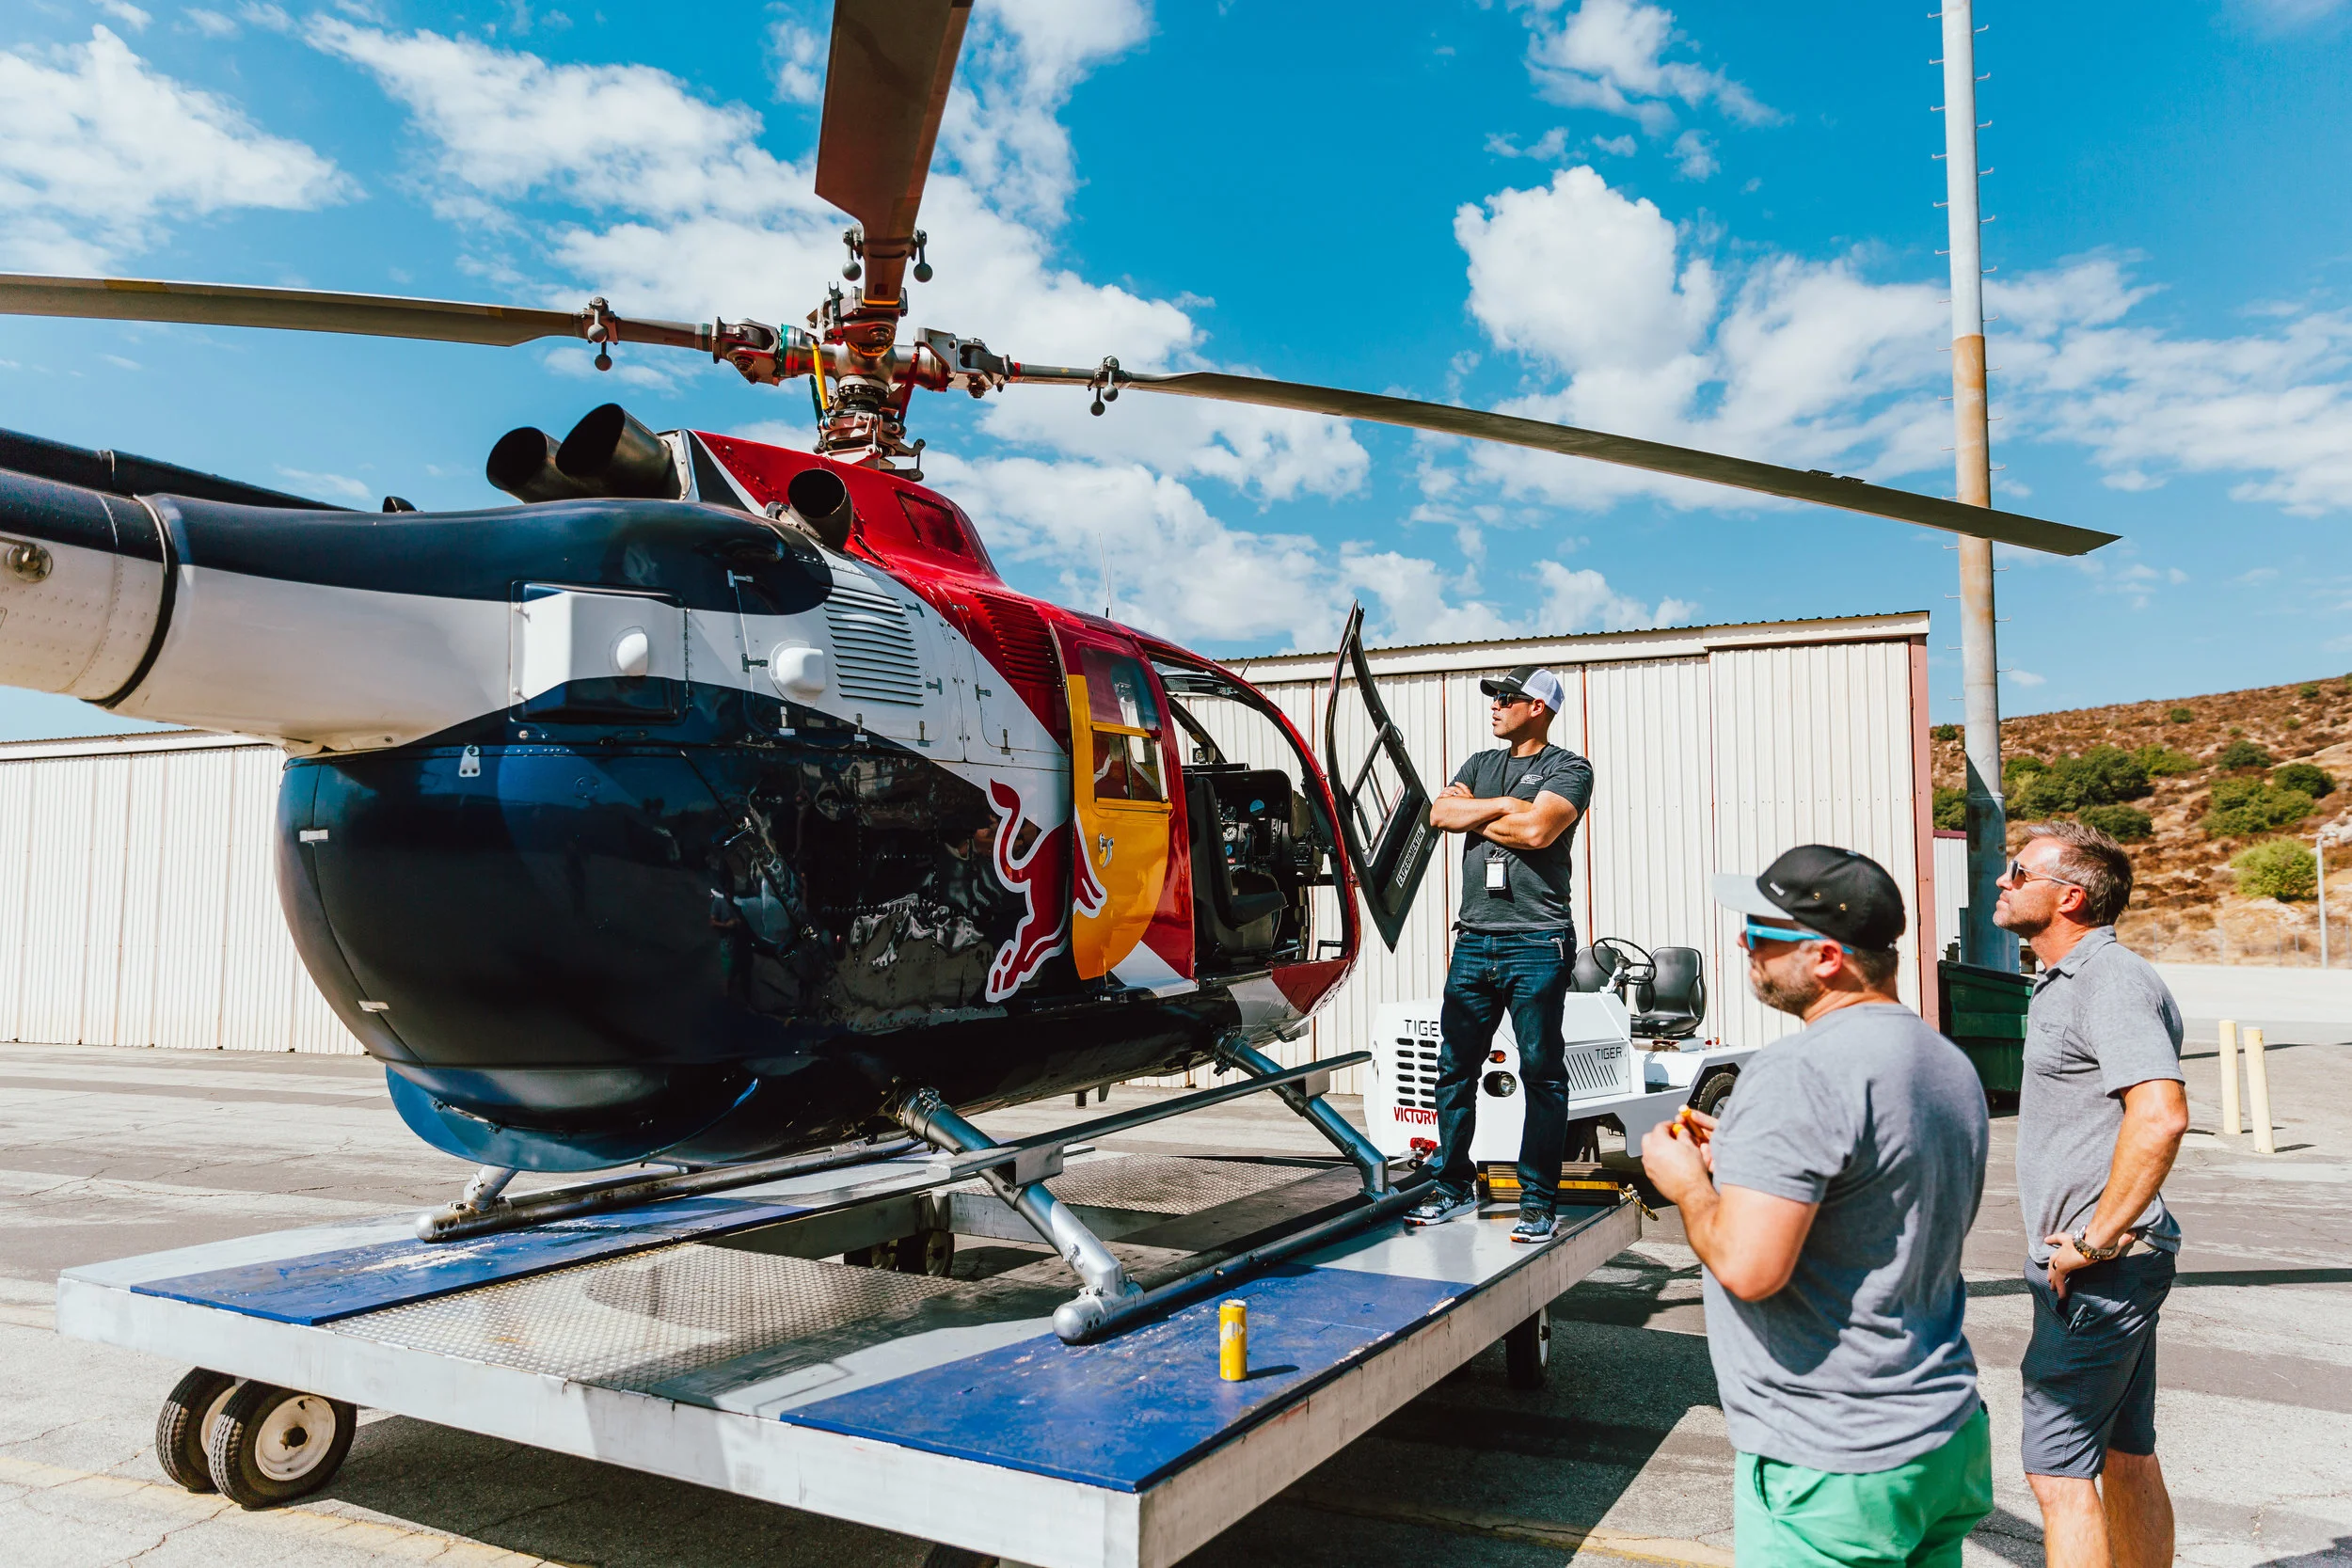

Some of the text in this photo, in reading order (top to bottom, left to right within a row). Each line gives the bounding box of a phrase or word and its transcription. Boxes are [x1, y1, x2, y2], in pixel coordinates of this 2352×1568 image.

[1397, 829, 1424, 885] EXPERIMENTAL
[1404, 1020, 1439, 1037] TIGE
[1595, 1046, 1623, 1060] TIGER
[1393, 1106, 1438, 1126] VICTORY
